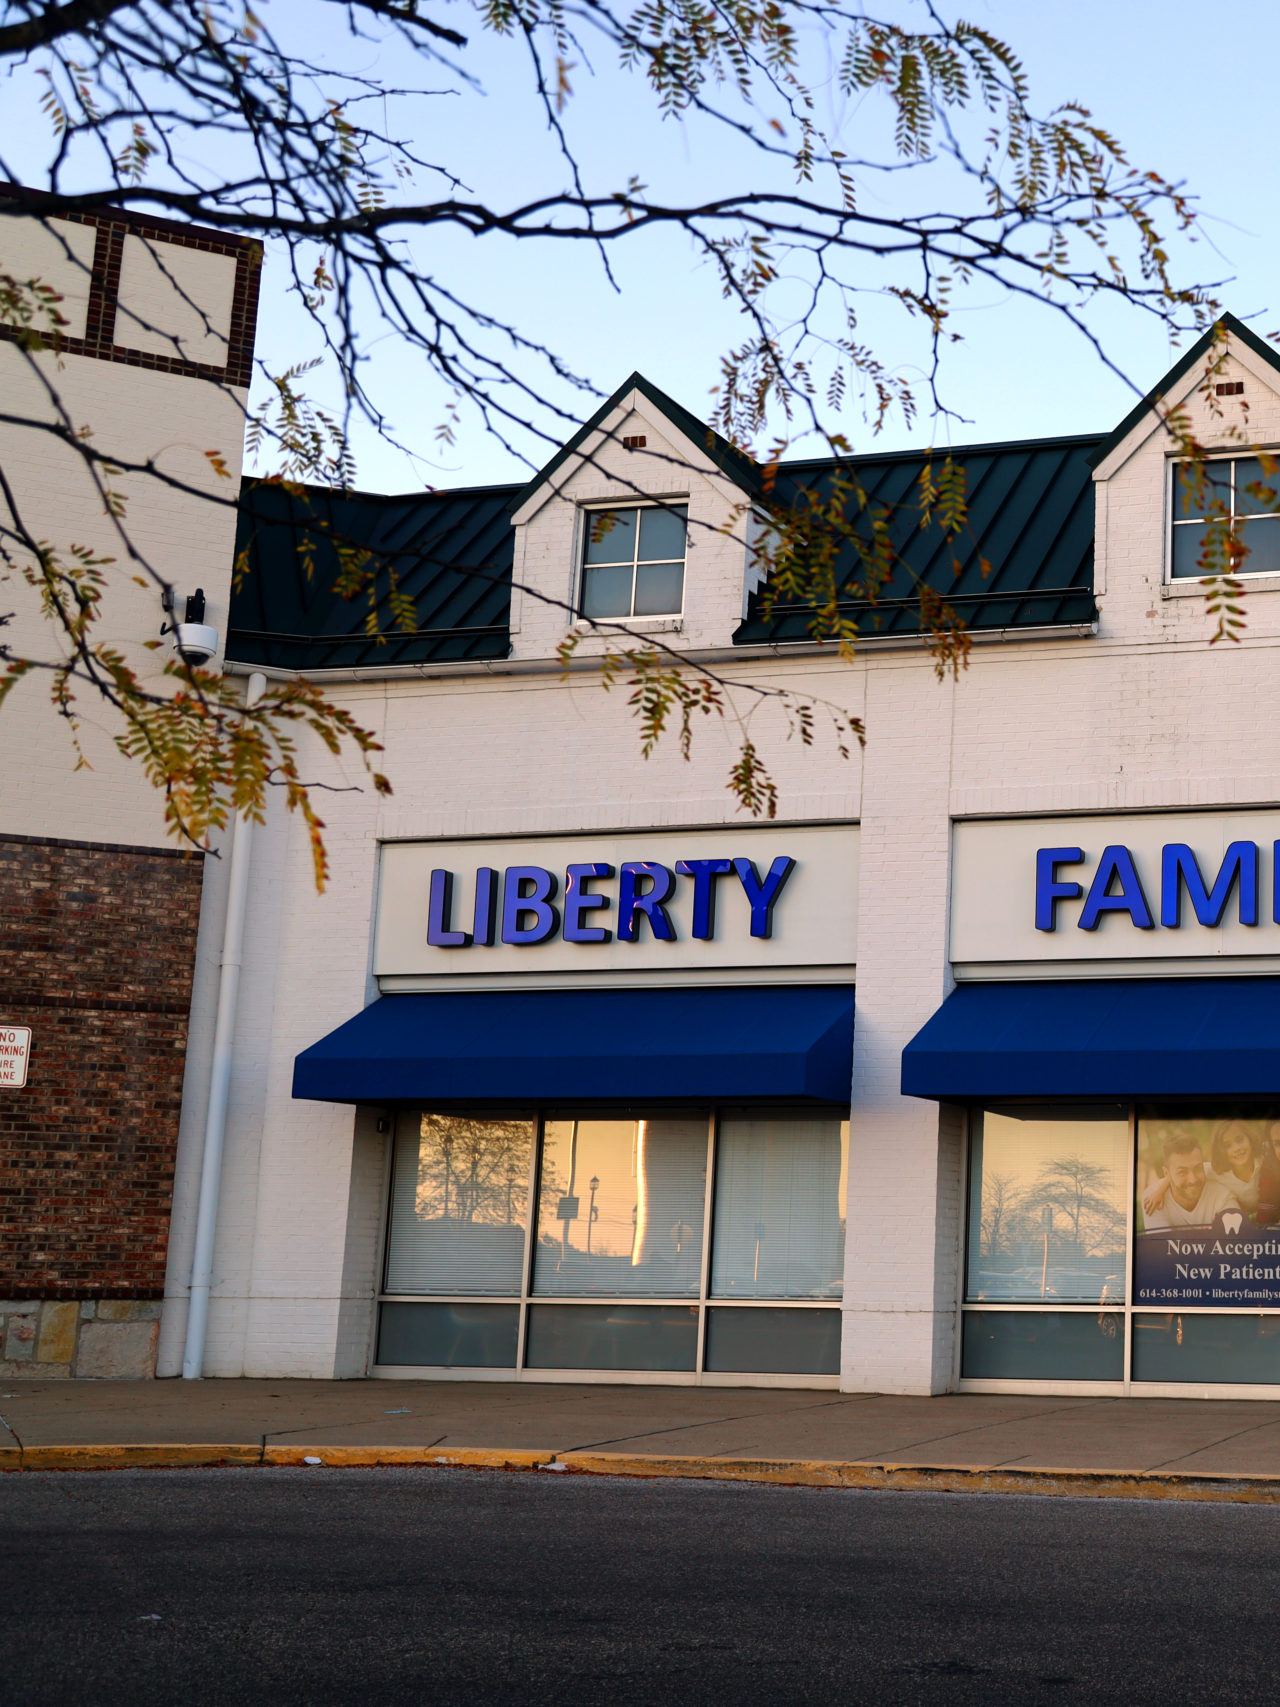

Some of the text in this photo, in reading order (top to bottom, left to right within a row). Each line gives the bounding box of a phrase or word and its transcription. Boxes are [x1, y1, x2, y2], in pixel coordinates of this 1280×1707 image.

[427, 856, 796, 947] LIBERTY
[0, 1032, 15, 1043] NO
[1167, 1239, 1206, 1255] Now
[1175, 1263, 1213, 1280] New
[1139, 1288, 1203, 1298] 614-368-1001
